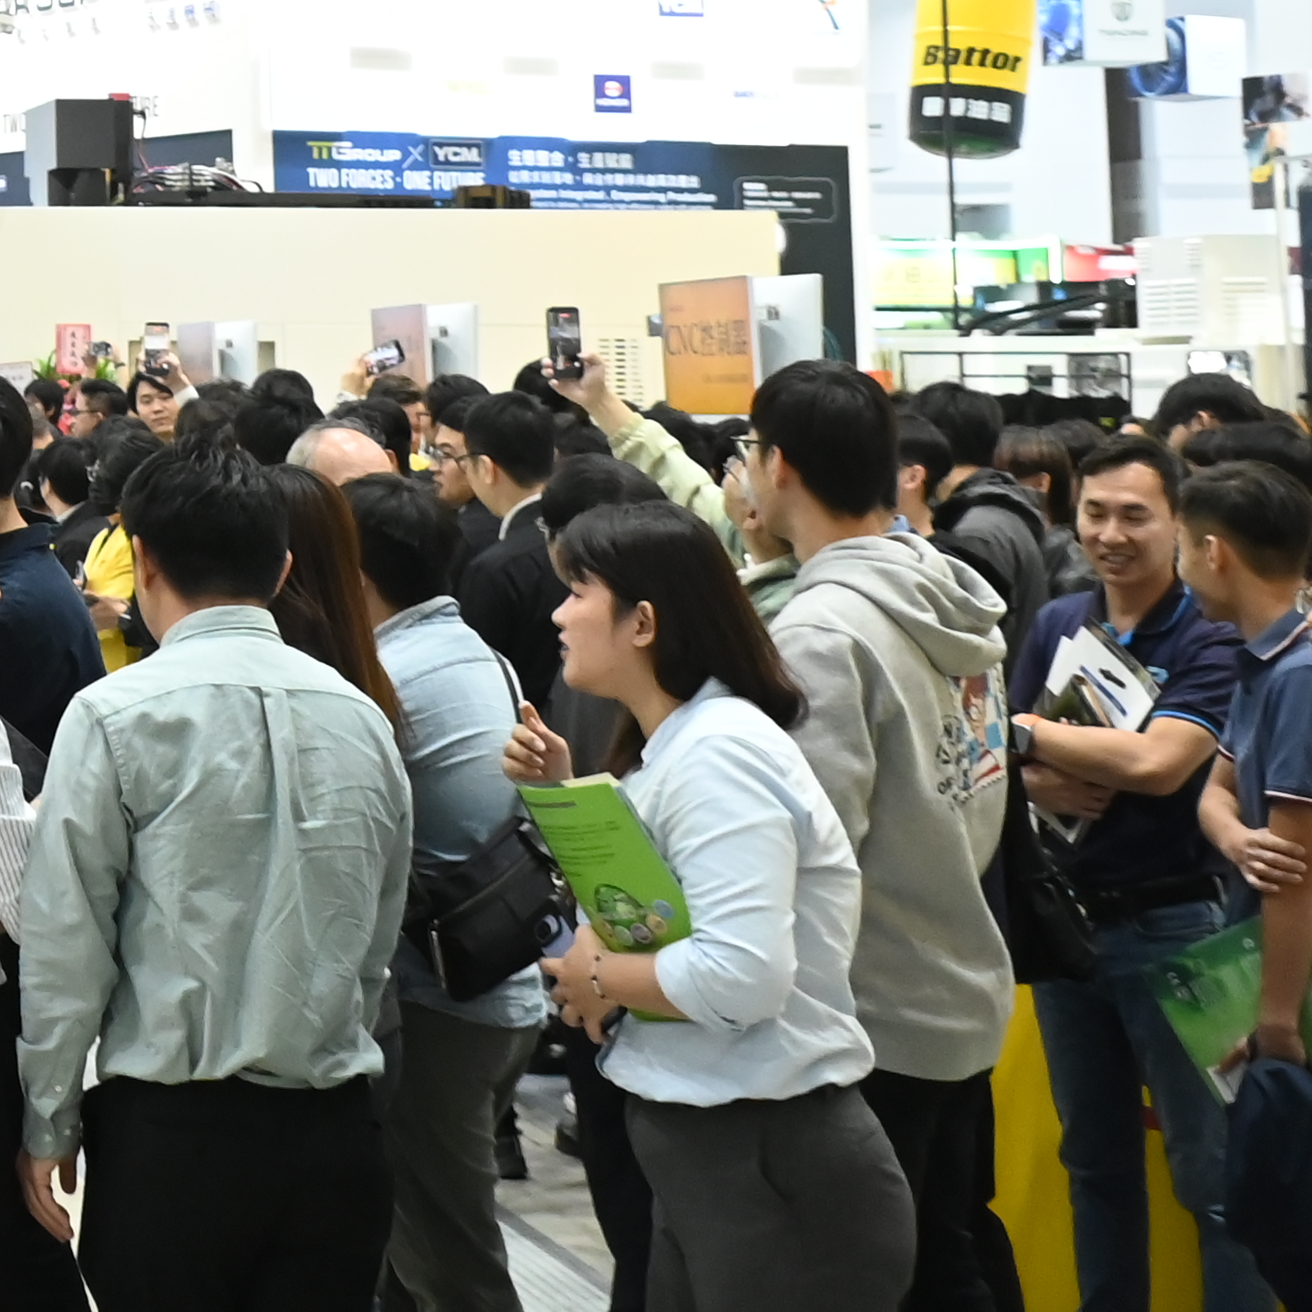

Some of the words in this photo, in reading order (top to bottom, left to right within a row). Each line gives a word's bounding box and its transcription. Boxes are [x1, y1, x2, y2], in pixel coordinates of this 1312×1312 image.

[306, 167, 339, 188] TWO
[340, 168, 395, 190] FORCES
[403, 170, 433, 191] ONE
